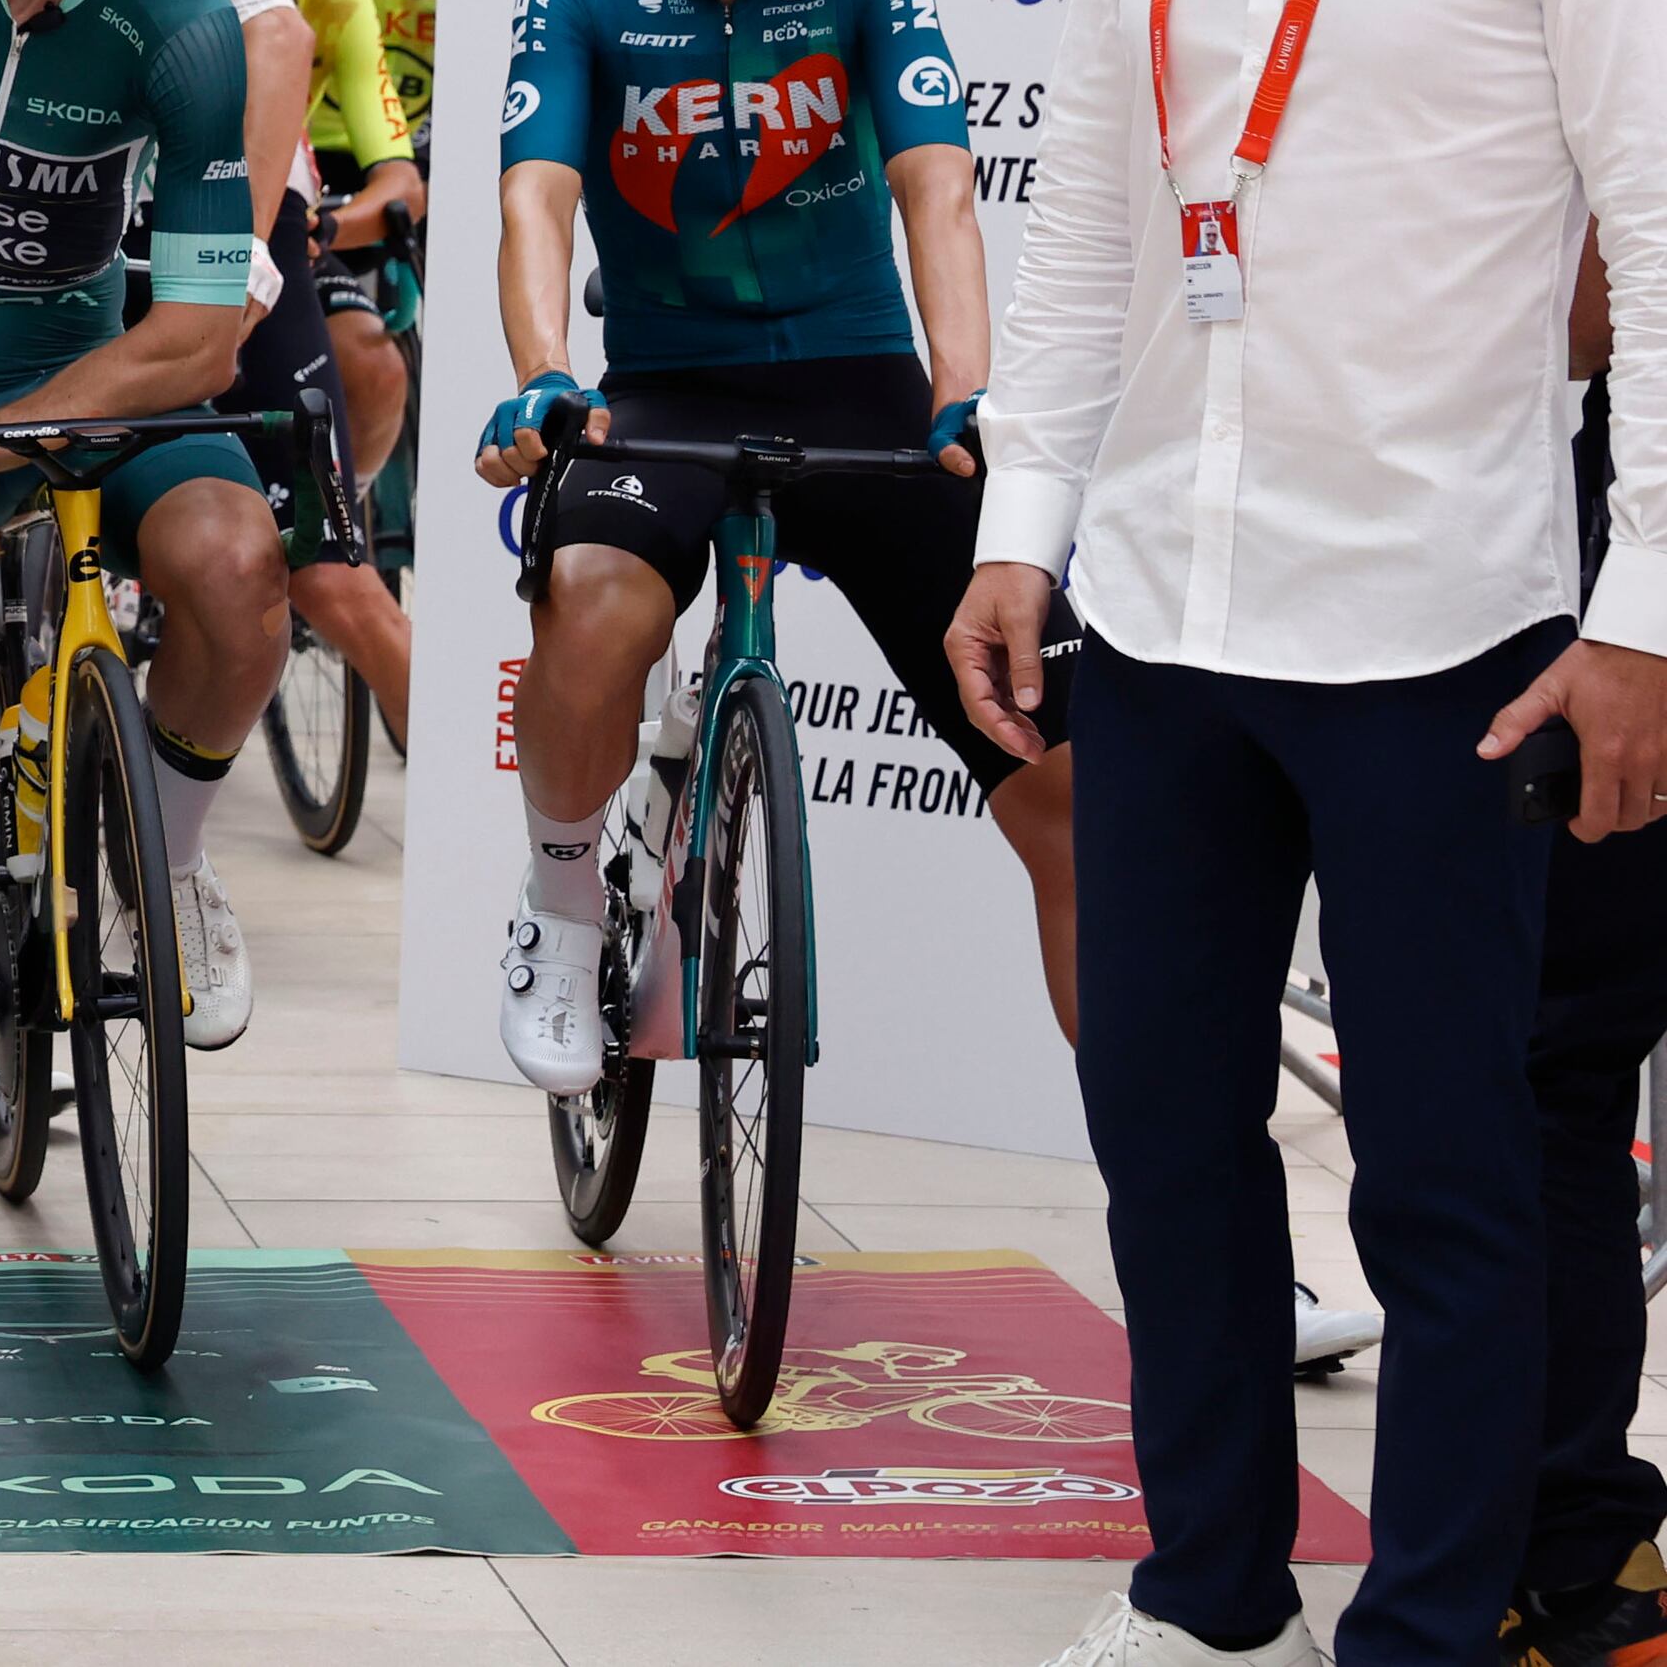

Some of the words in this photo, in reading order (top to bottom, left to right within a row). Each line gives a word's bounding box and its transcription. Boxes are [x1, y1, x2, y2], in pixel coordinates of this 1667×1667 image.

[763, 0, 825, 17] ETXEONDO
[620, 32, 696, 48] GIANT
[1280, 24, 1299, 60] VUELTA
[622, 76, 845, 135] KERN
[622, 133, 847, 163] PHARMA
[785, 170, 865, 208] Oxicol
[3, 426, 60, 440] cervélo
[812, 759, 854, 804] LA
[286, 1513, 436, 1529] PUNTOS
[640, 1520, 825, 1533] GANADOR
